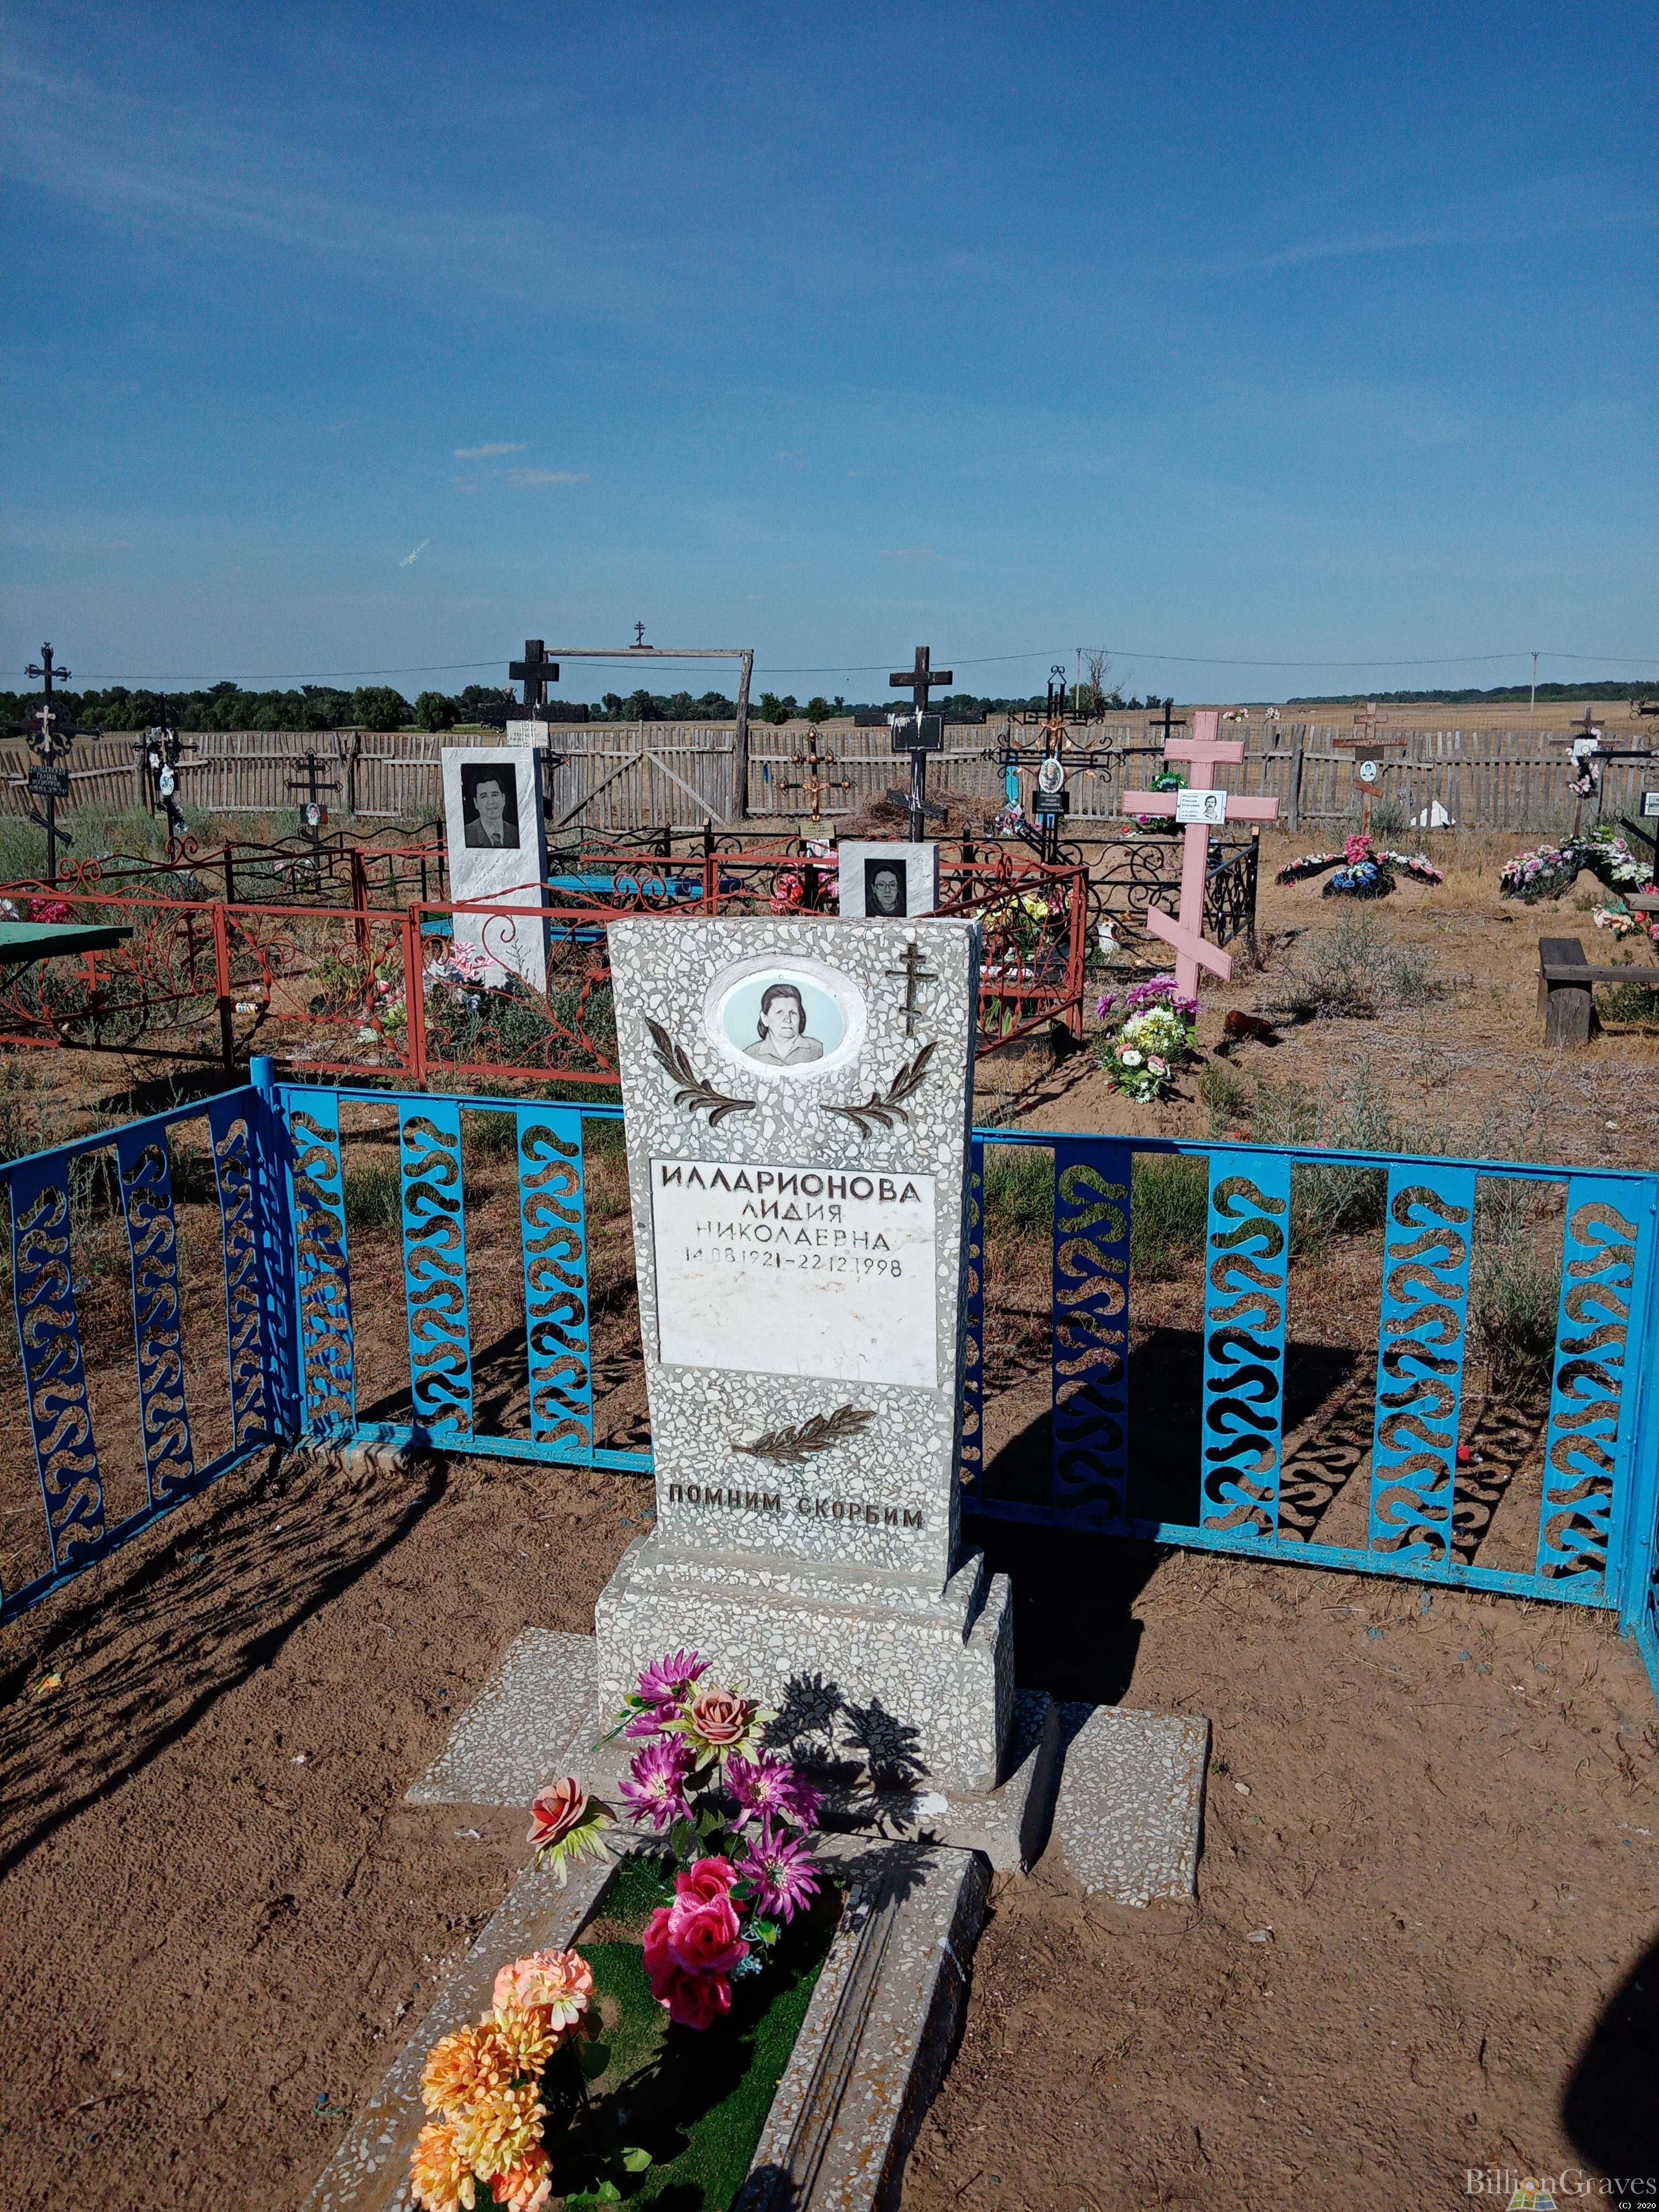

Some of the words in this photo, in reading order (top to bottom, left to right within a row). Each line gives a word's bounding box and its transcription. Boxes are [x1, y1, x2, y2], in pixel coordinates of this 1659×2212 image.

[661, 1165, 921, 1203] ИЛЛАРИОНОВА
[742, 1199, 842, 1223] ЛИДИЯ
[696, 1220, 891, 1251] НИКОЛАЕВНА
[669, 1484, 781, 1512] ПОМНИМ
[798, 1496, 923, 1529] СКОРБИМ
